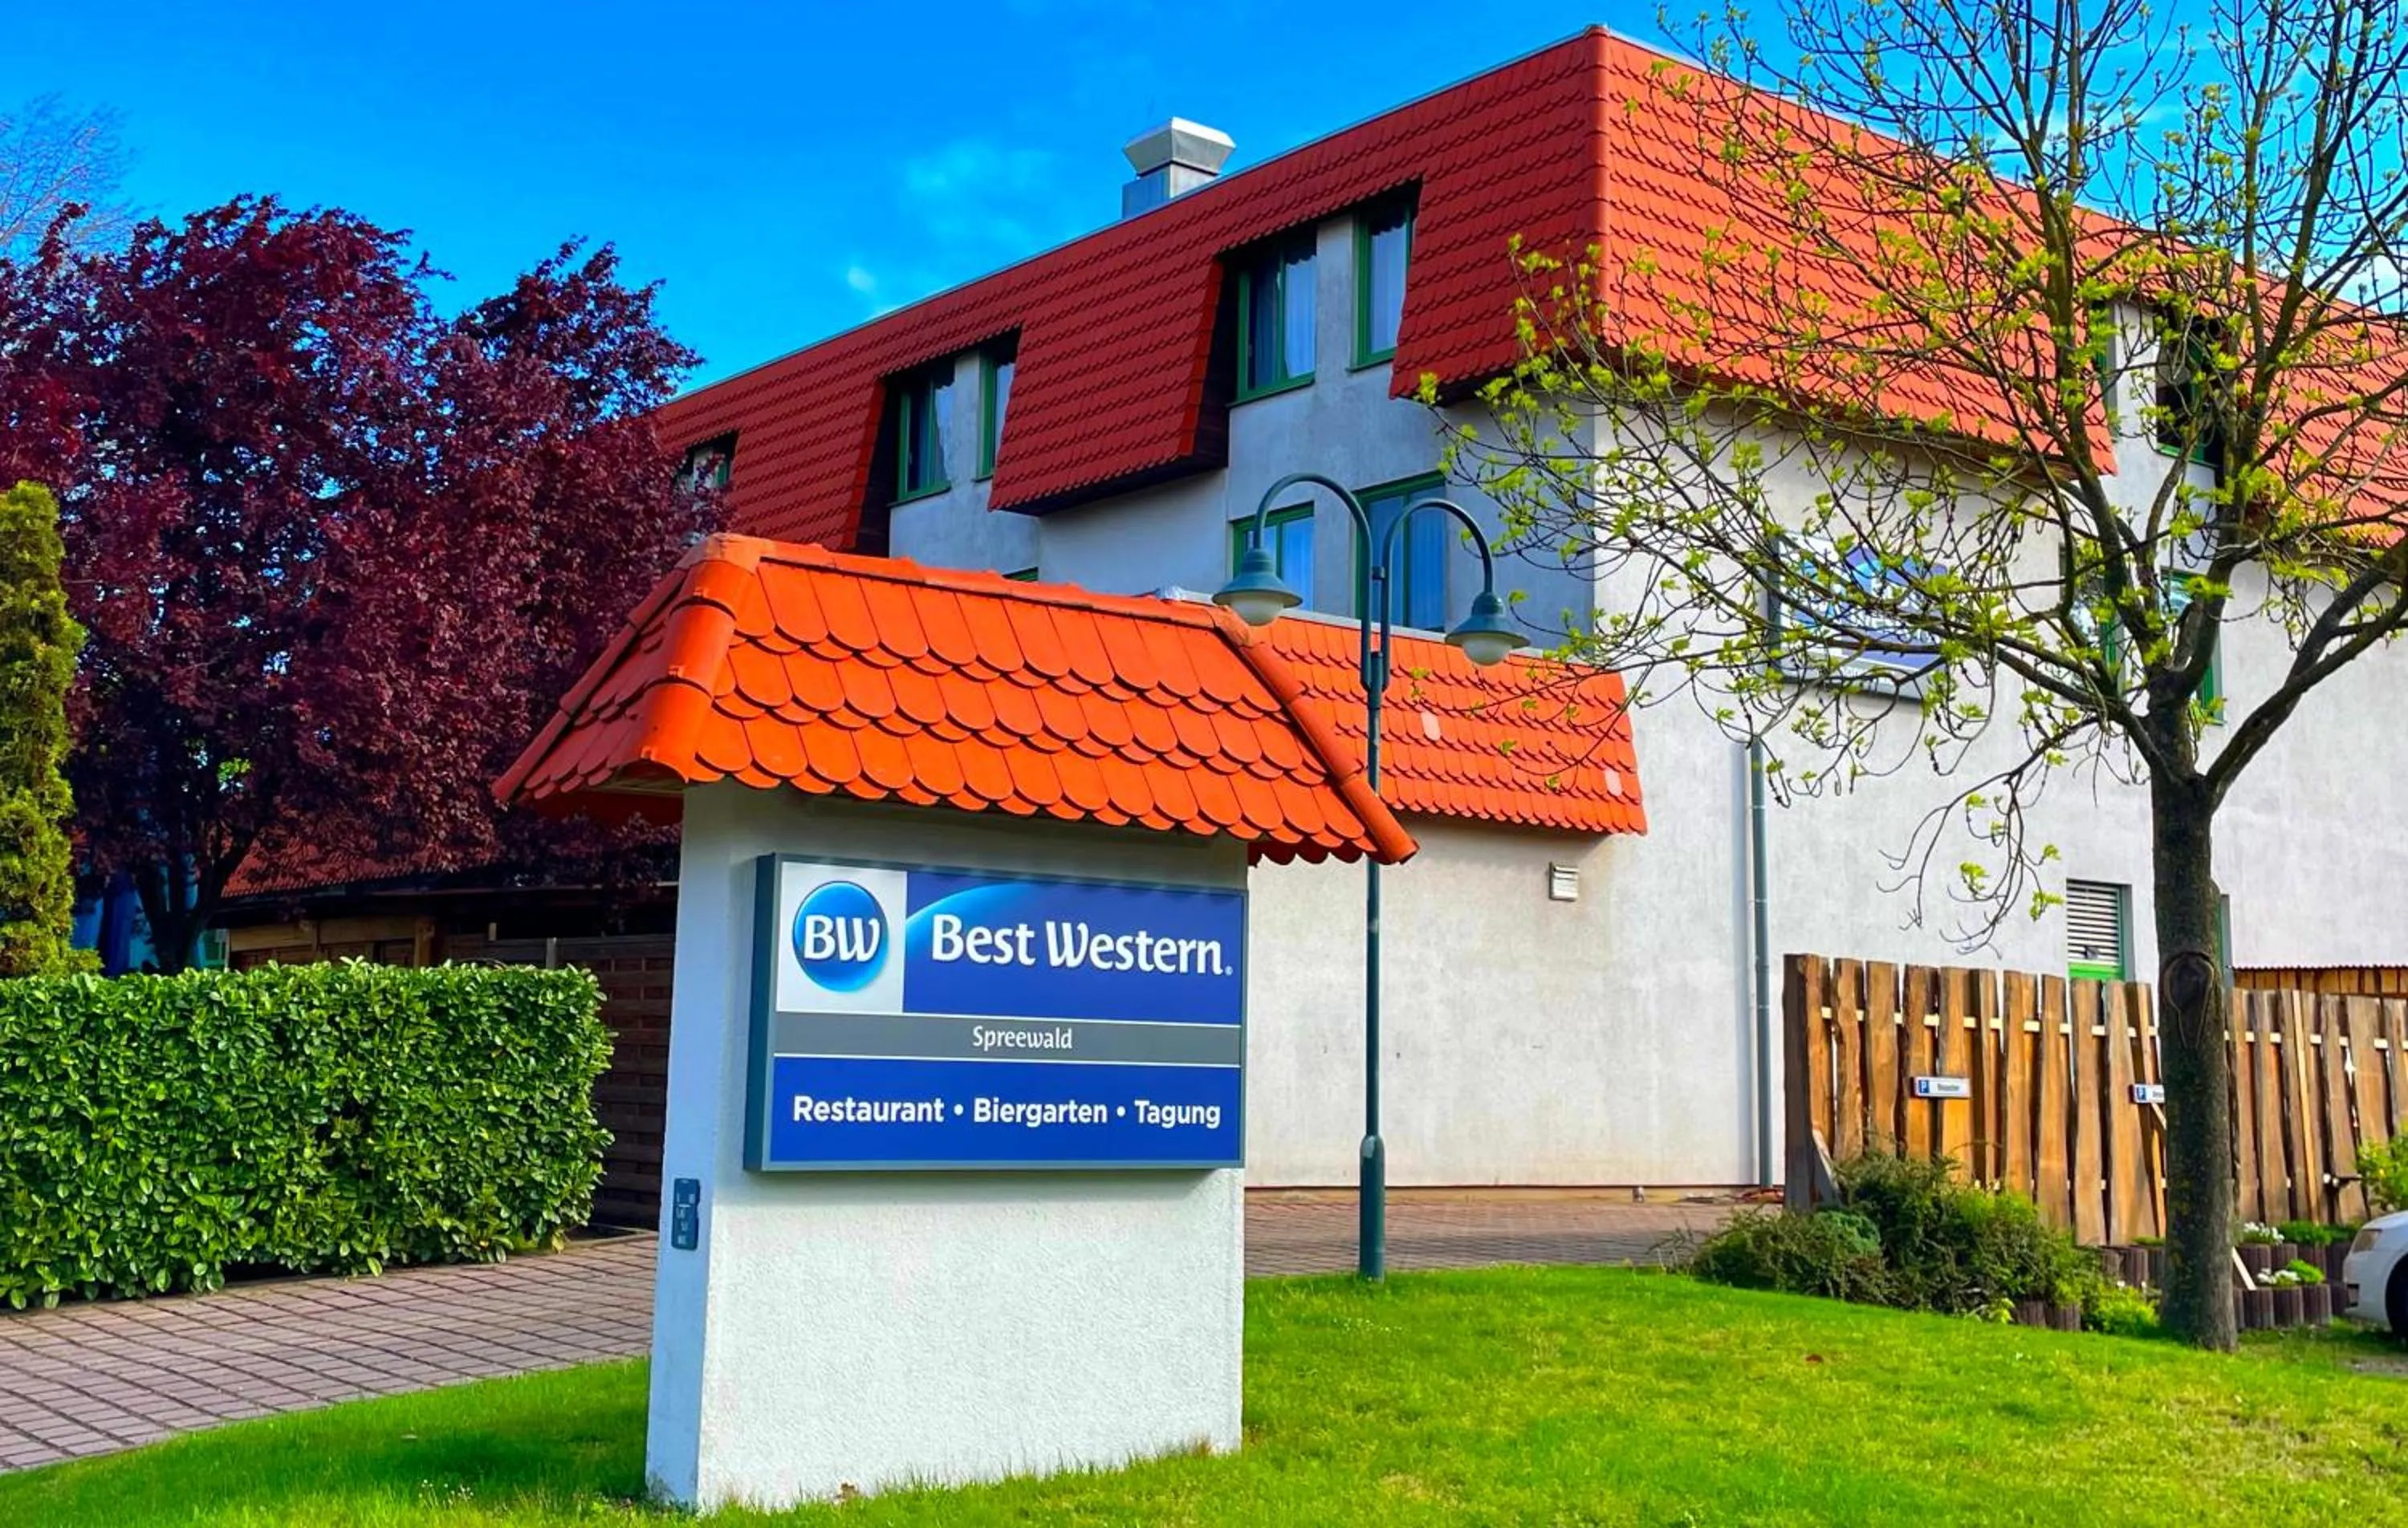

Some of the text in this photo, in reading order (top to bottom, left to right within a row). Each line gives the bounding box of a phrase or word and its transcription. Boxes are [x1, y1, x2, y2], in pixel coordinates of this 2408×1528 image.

[804, 913, 881, 962] BW
[932, 914, 1035, 965] Best
[972, 1026, 1073, 1052] Spreewald
[793, 1095, 1221, 1129] Restaurant Biergarten Tagung
